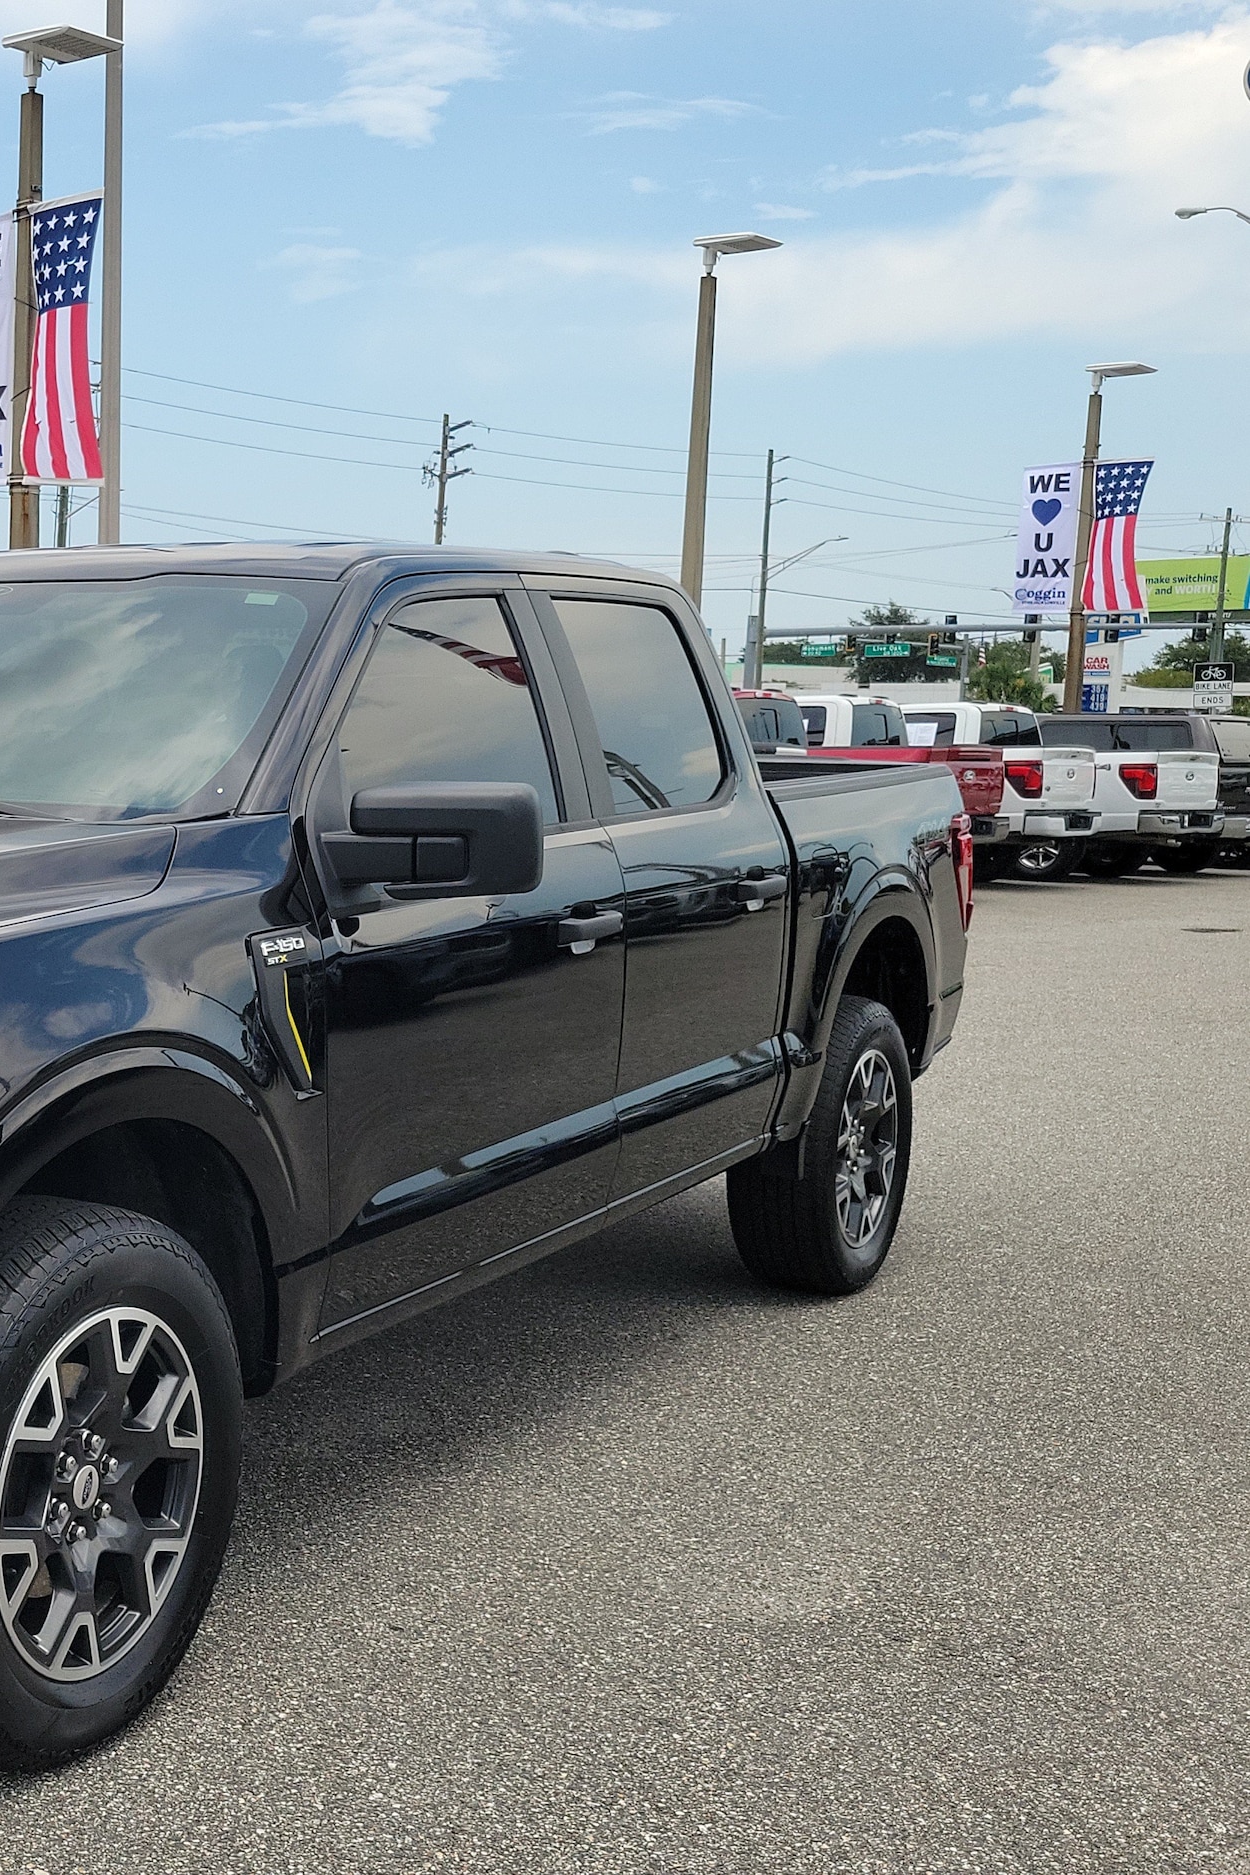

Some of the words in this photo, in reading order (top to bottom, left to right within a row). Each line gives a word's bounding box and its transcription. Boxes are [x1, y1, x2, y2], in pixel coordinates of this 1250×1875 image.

[1029, 472, 1071, 494] WE
[1035, 533, 1053, 552] U
[1016, 558, 1070, 578] JAX
[1146, 576, 1170, 584] make
[1172, 573, 1218, 583] switching
[1015, 587, 1066, 601] Coggin
[1155, 586, 1172, 595] and
[1195, 682, 1210, 690] BIKE
[1213, 682, 1230, 690] LANE
[261, 937, 305, 956] F-150
[267, 954, 288, 965] STX
